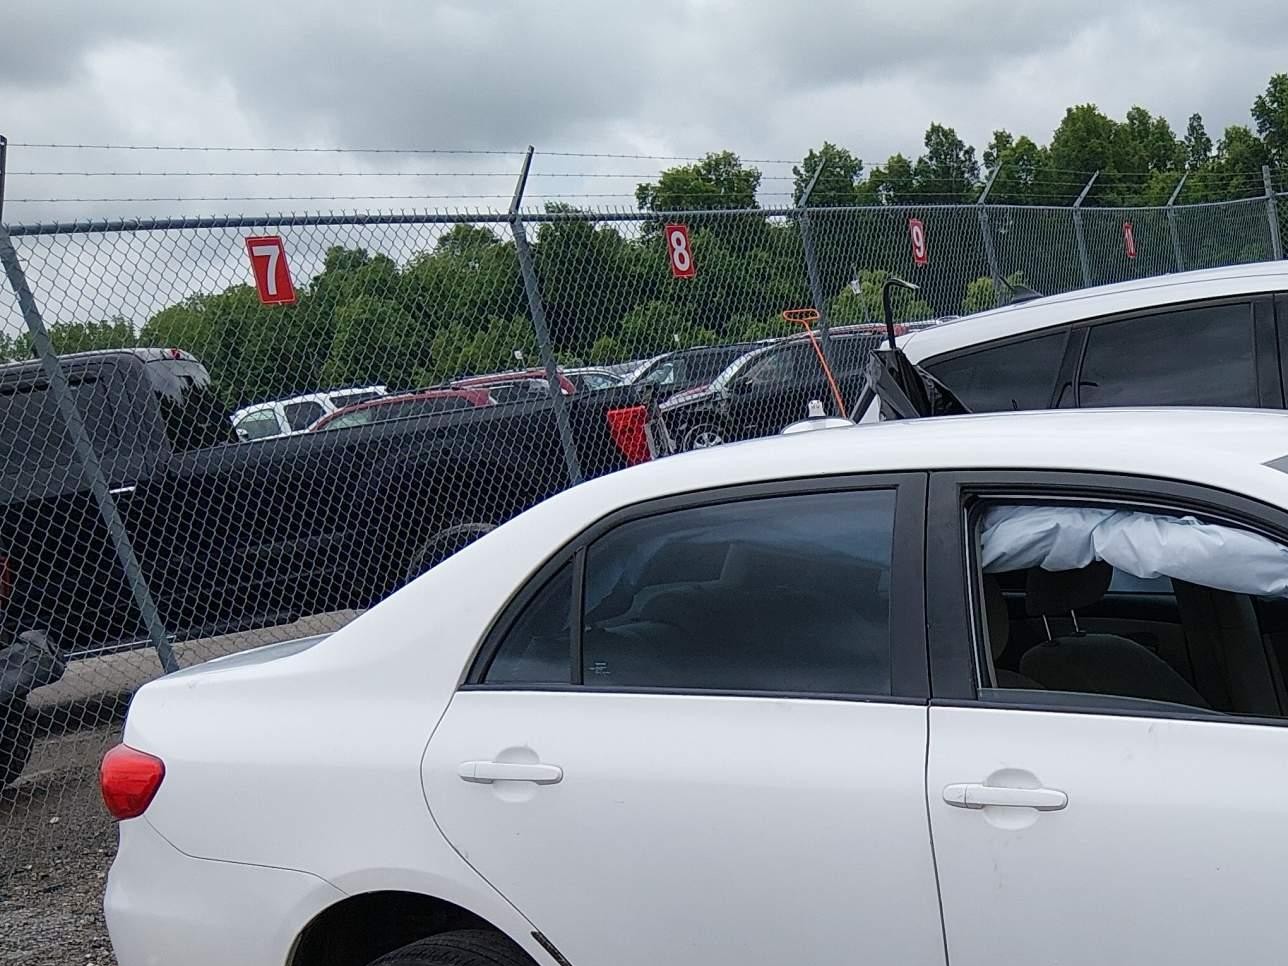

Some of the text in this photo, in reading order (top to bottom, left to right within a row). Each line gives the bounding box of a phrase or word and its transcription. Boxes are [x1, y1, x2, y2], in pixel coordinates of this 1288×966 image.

[671, 231, 690, 271] 8
[913, 226, 924, 257] 9
[252, 245, 280, 295] 7
